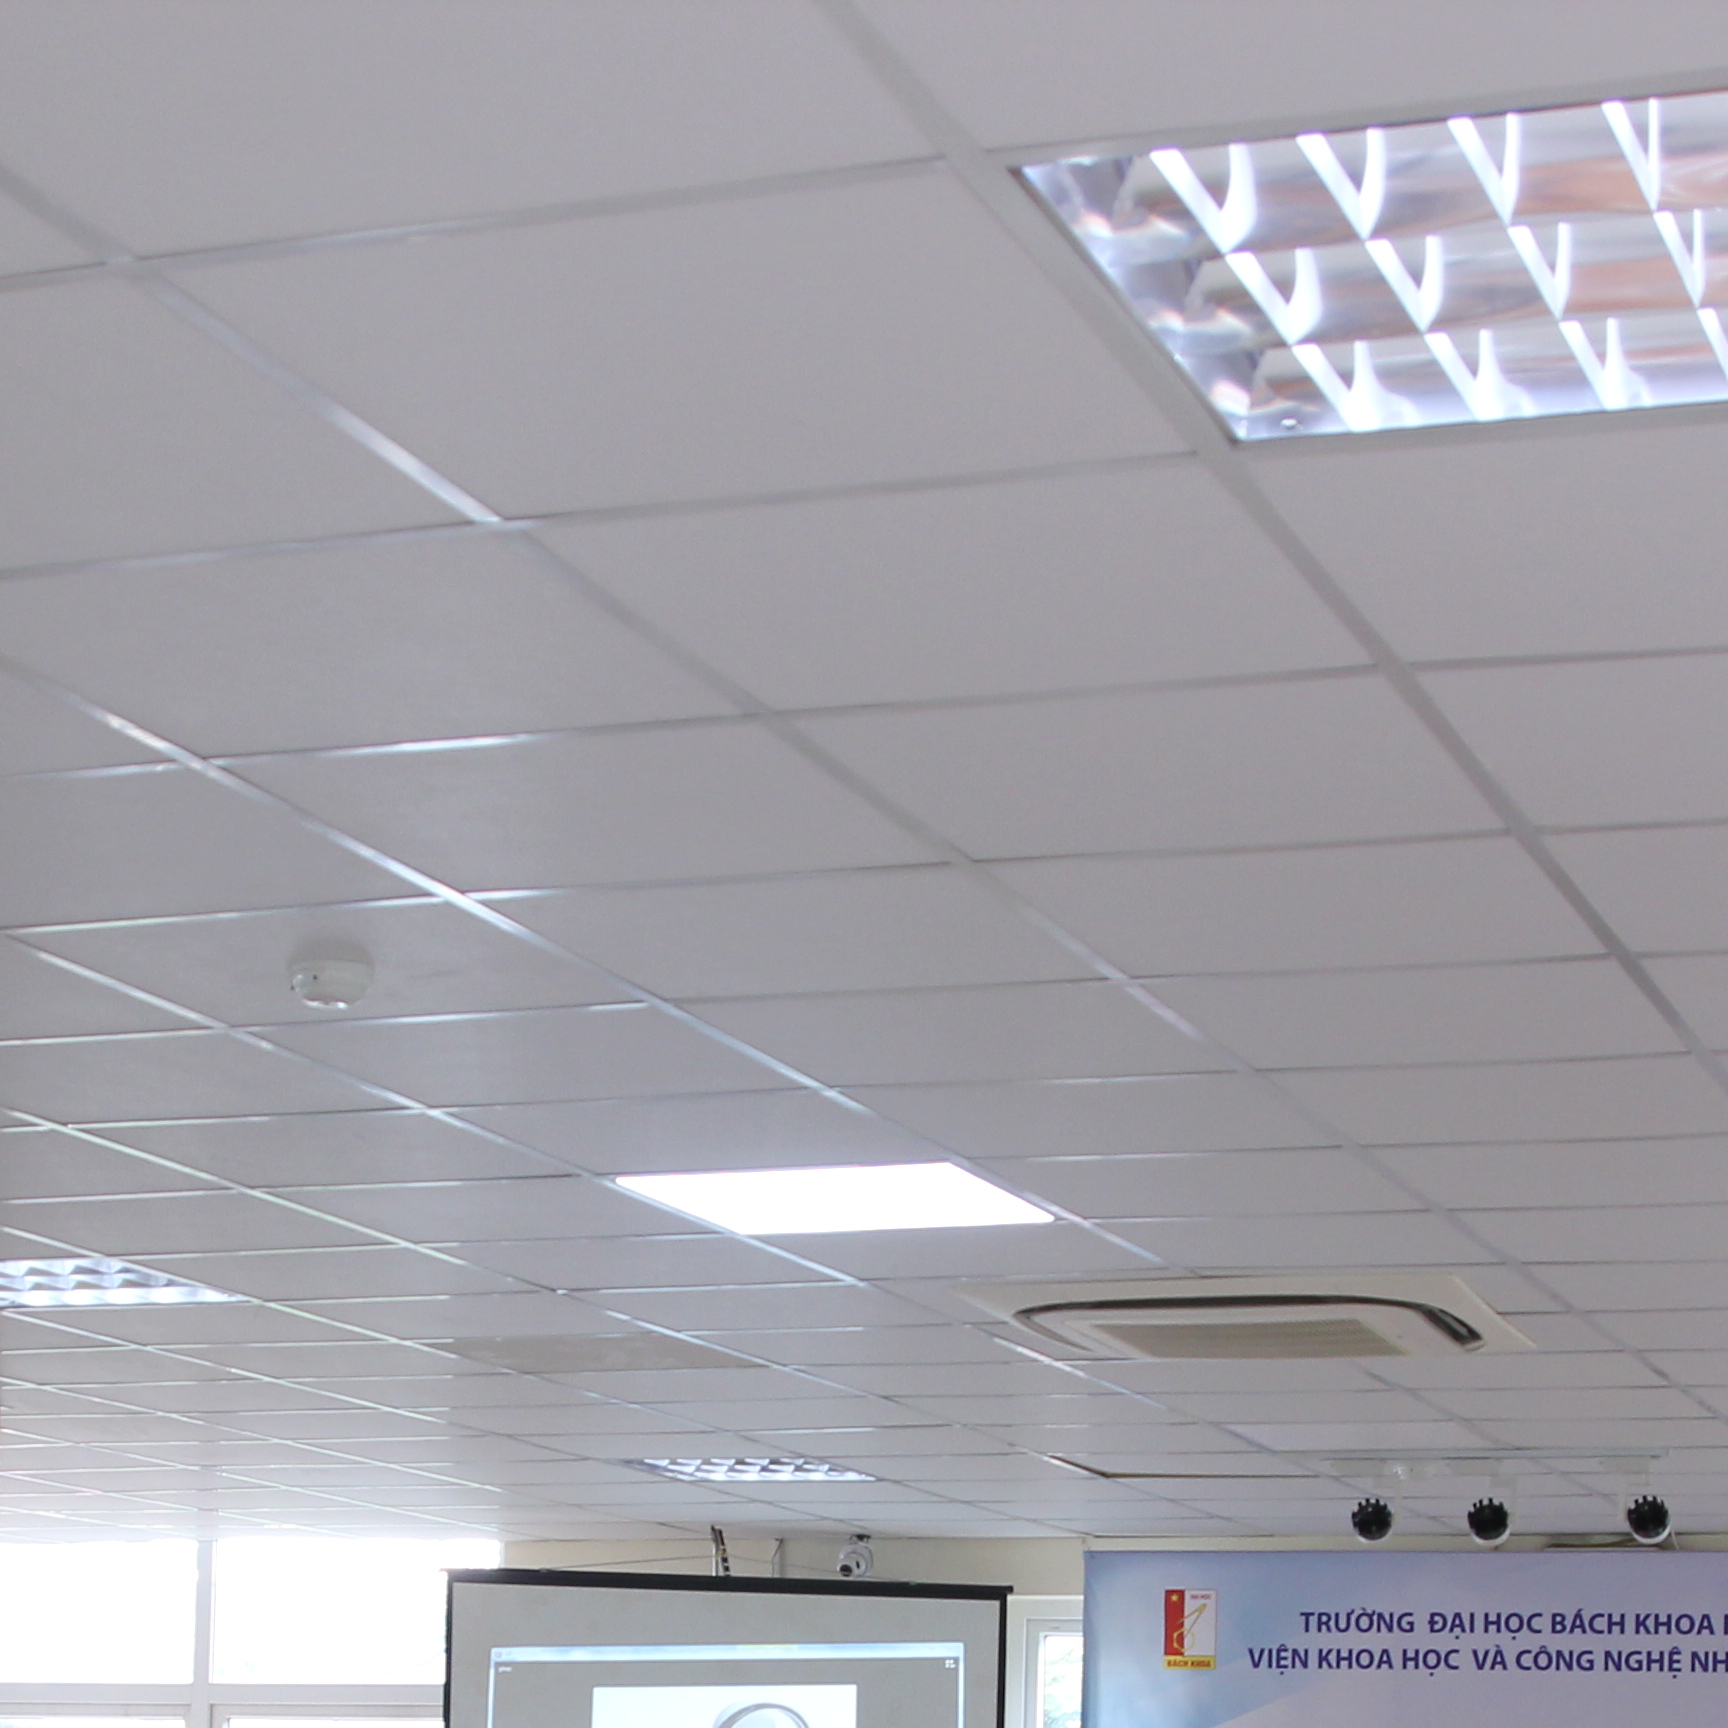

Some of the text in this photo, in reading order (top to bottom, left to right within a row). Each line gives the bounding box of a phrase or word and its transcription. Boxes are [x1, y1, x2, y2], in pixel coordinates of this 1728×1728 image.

[1299, 1607, 1415, 1634] TRƯỜNG
[1427, 1610, 1475, 1640] ĐẠI
[1482, 1610, 1543, 1641] HỌC
[1550, 1607, 1626, 1636] BÁCH
[1634, 1612, 1716, 1636] KHOA
[1246, 1644, 1310, 1676] VIỆN
[1317, 1648, 1394, 1670] KHOA
[1401, 1649, 1461, 1677] HỌC
[1471, 1643, 1509, 1671] VÀ
[1514, 1642, 1595, 1673] CÔNG
[1603, 1646, 1682, 1679] NGHỆ
